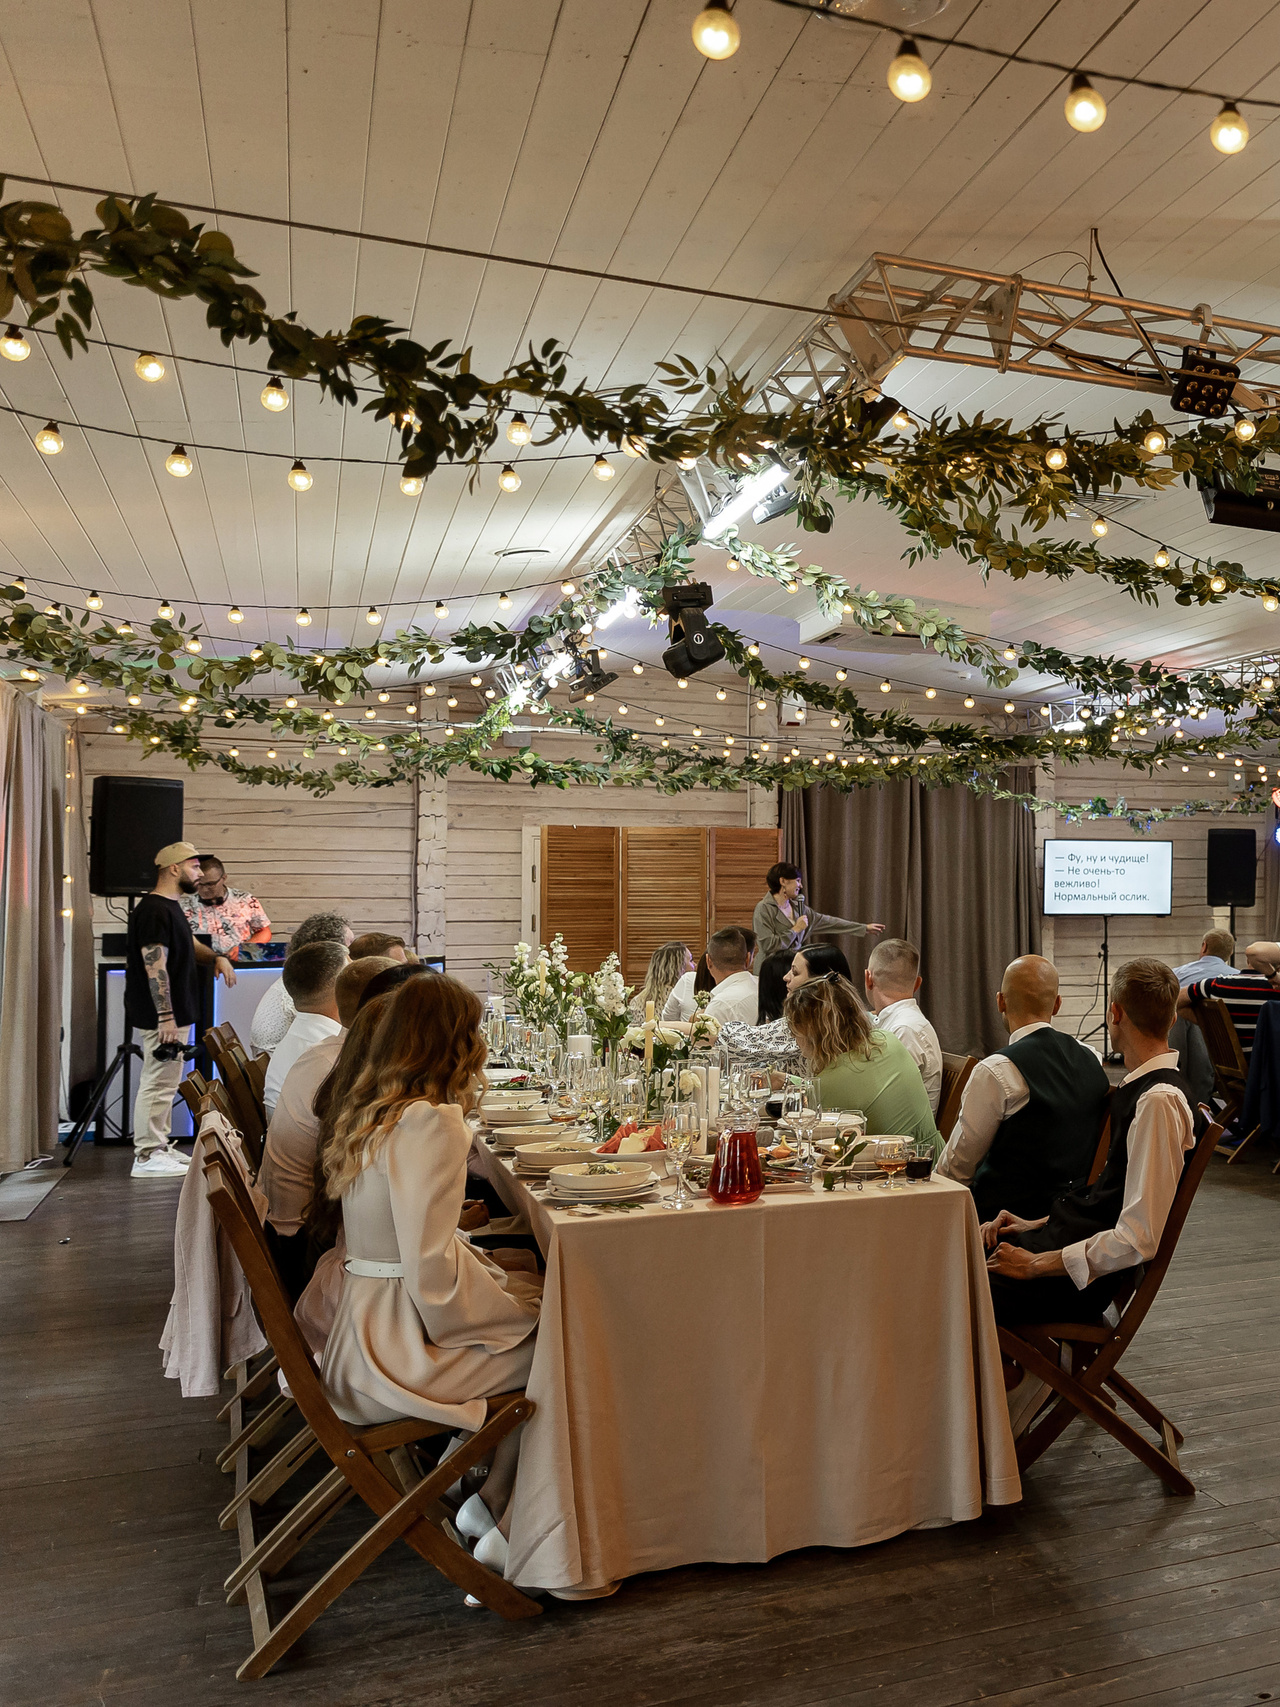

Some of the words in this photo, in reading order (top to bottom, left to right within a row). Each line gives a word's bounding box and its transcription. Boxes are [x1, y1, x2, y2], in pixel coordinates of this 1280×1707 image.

[1067, 853, 1084, 864] Фу,
[1086, 855, 1098, 864] ну
[1108, 853, 1149, 864] чудище!
[1067, 866, 1081, 875] Не
[1083, 866, 1126, 875] очень-то
[1054, 879, 1100, 888] вежливо!
[1053, 892, 1117, 903] Нормальный
[1119, 892, 1150, 901] ослик.
